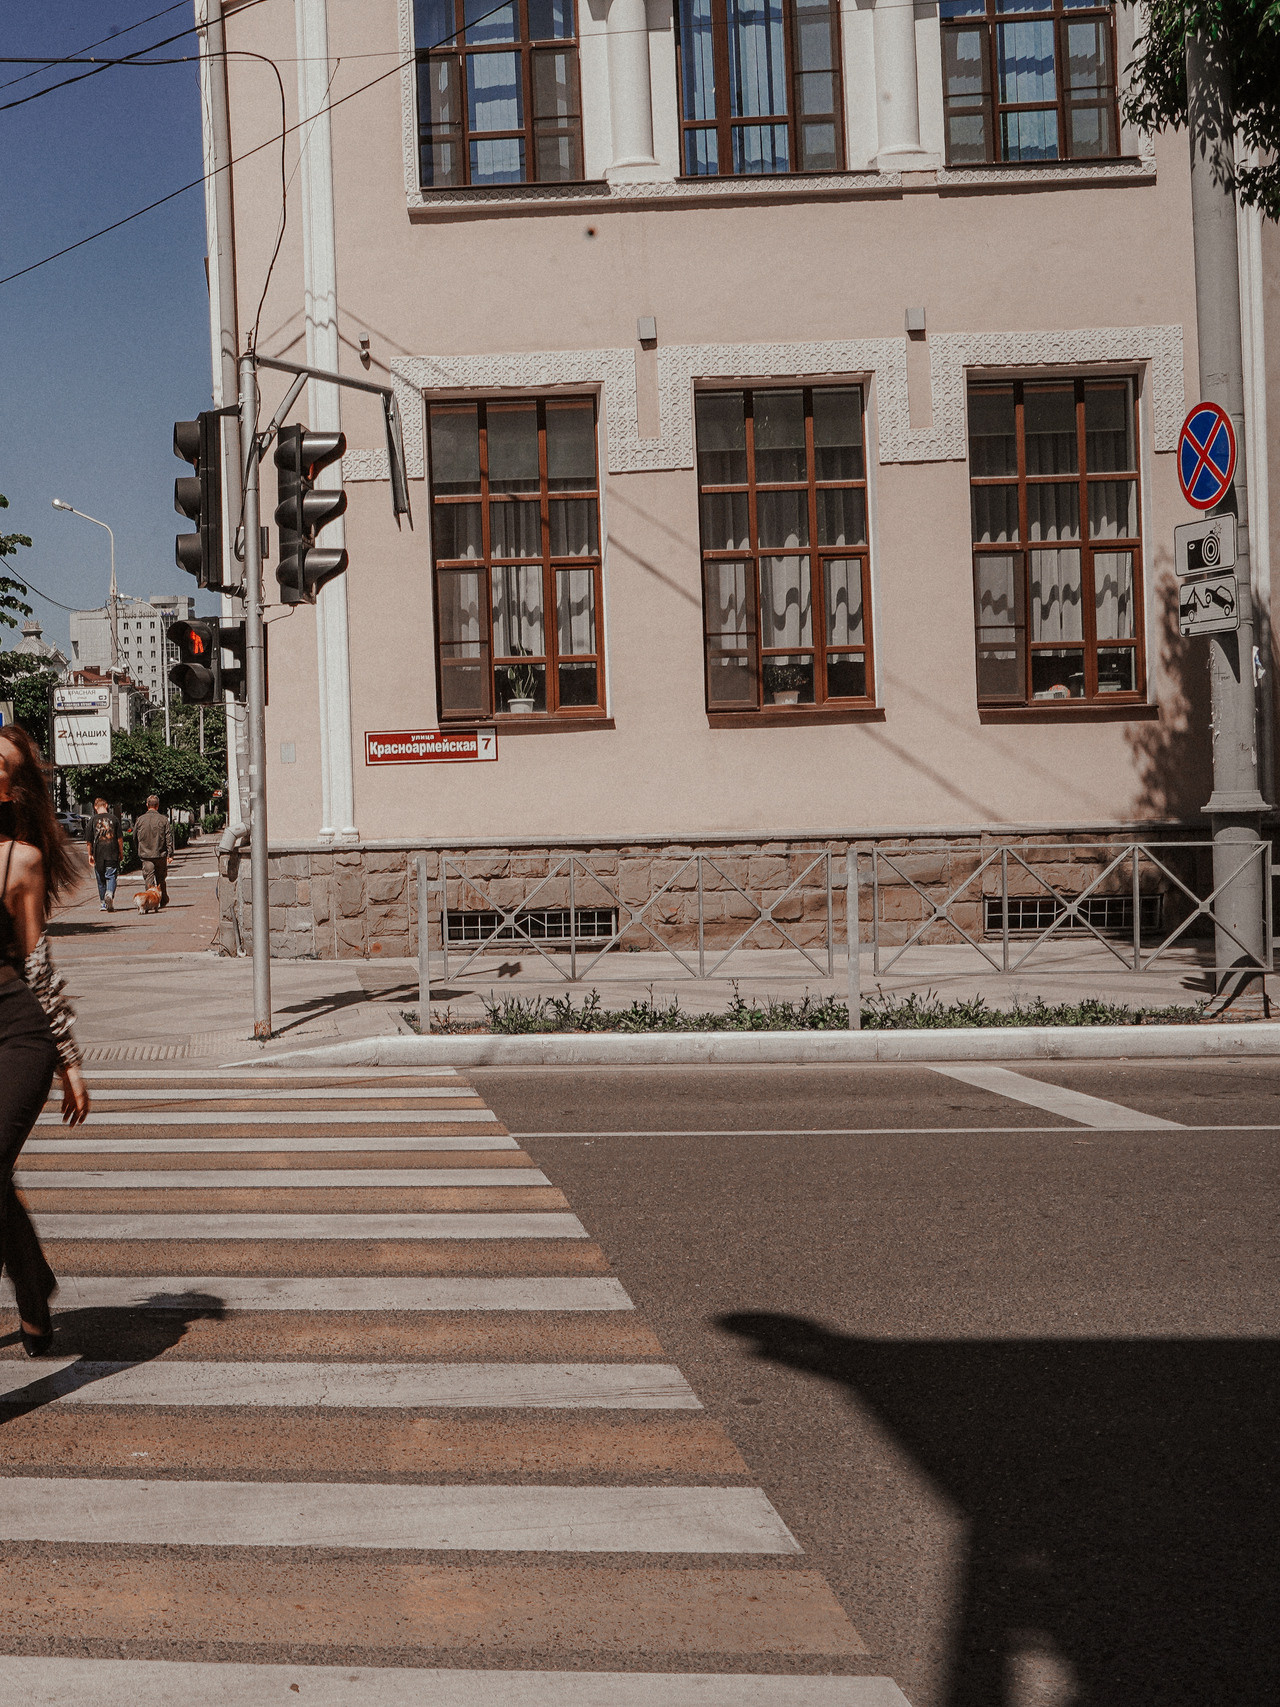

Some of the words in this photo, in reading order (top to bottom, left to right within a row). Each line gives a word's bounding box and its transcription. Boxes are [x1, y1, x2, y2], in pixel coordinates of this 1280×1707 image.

[76, 730, 107, 738] НАШИХ
[370, 739, 476, 757] Красноармейская
[482, 738, 491, 750] 7
